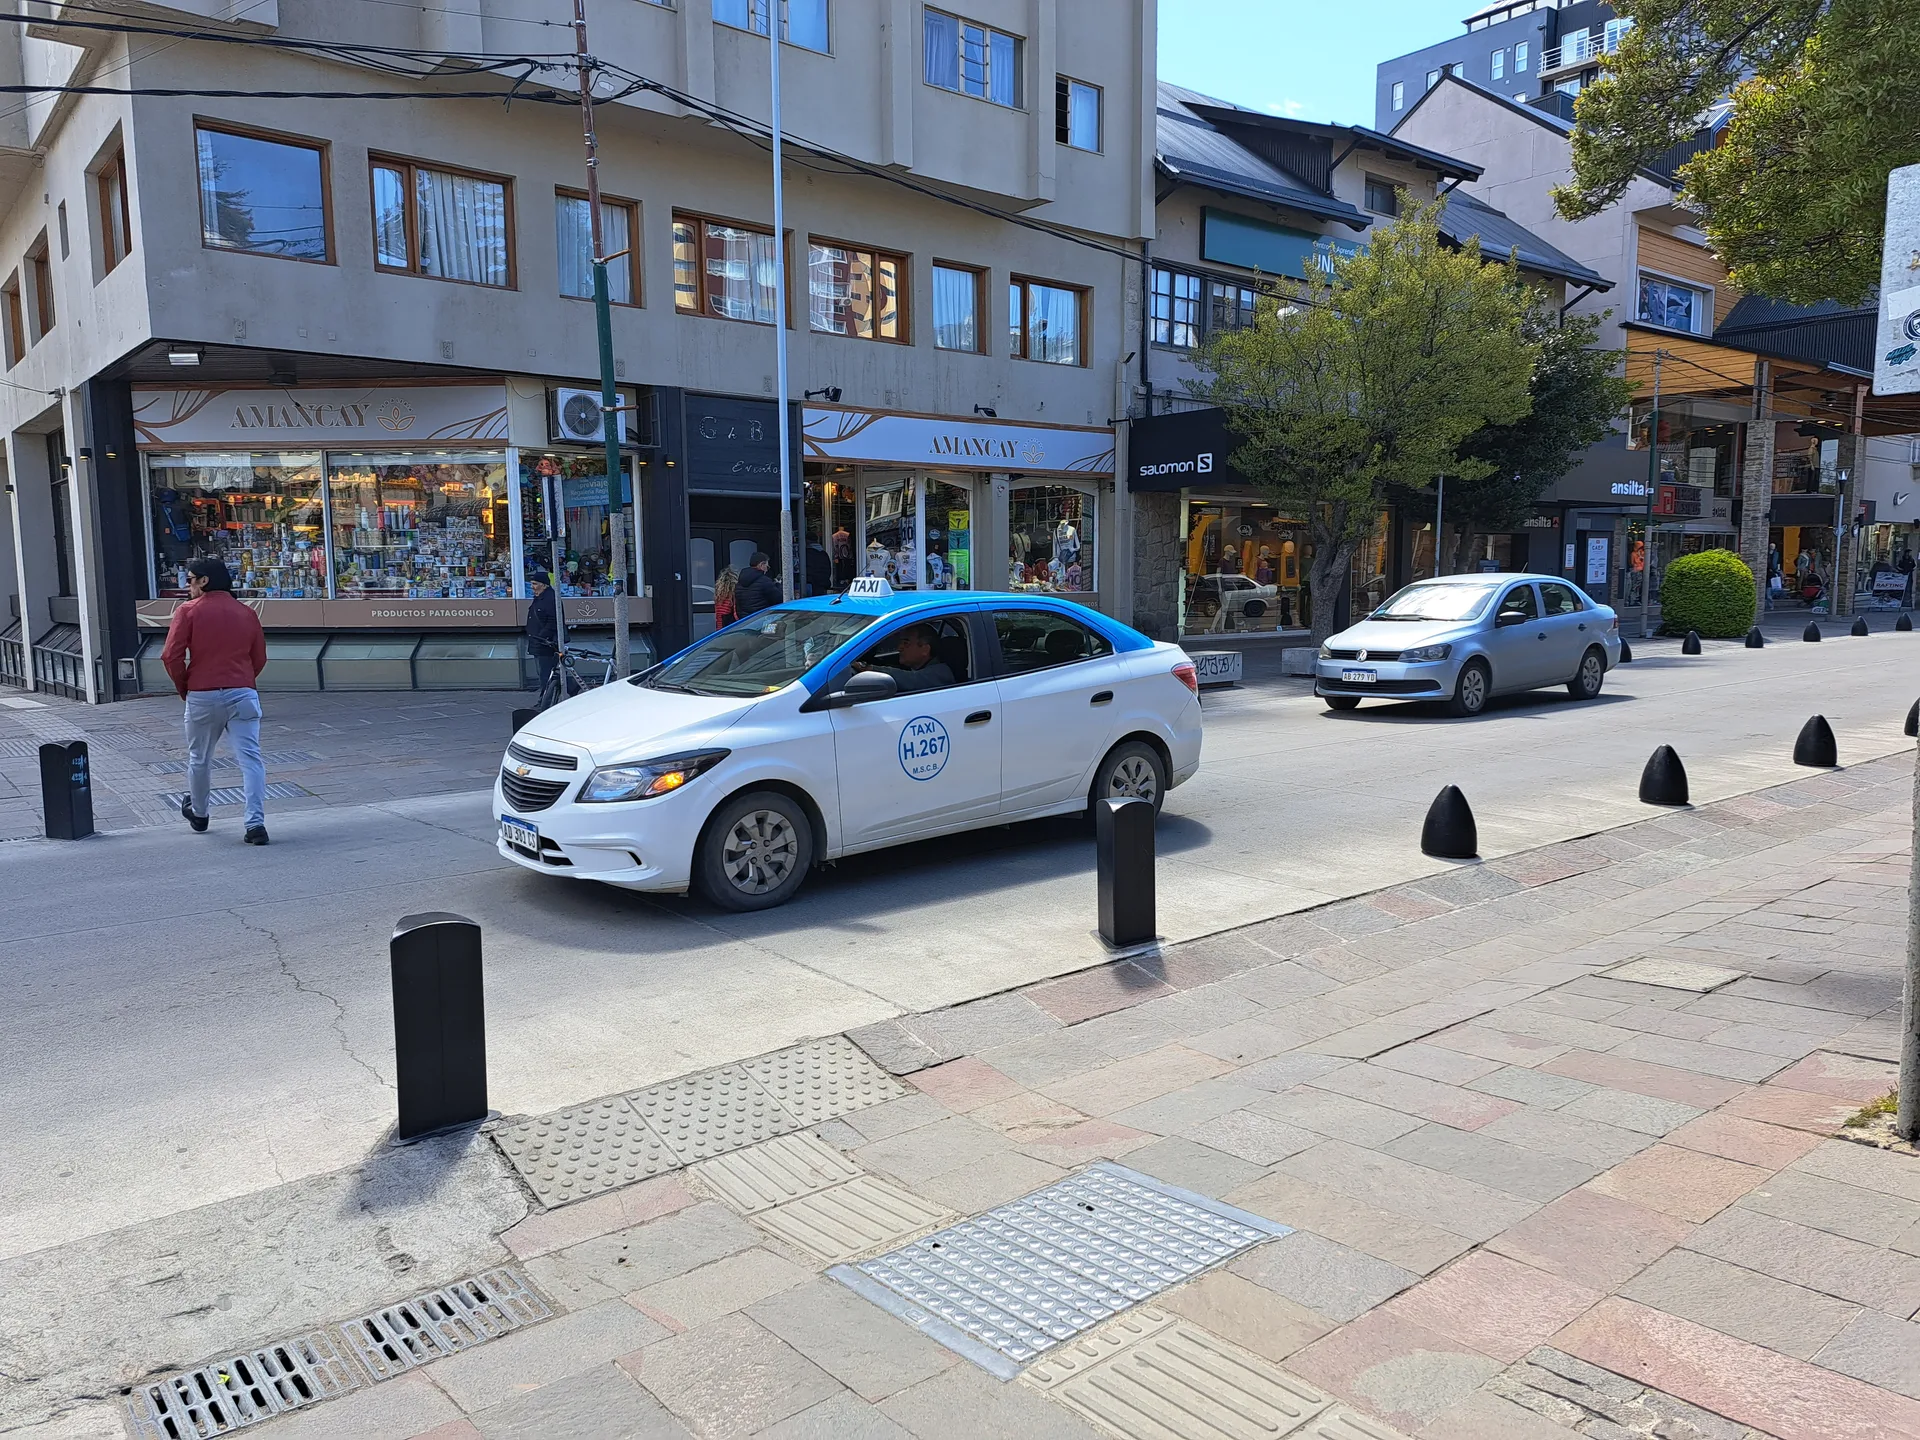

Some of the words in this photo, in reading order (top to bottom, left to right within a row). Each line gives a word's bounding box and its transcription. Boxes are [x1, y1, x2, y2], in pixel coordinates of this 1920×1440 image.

[230, 404, 371, 428] AMANCAY
[928, 435, 1019, 458] AMANCAY
[1140, 461, 1194, 476] salomon
[1611, 480, 1644, 496] ansilta
[1524, 517, 1551, 528] ansilta
[853, 580, 880, 593] TAXI
[371, 609, 426, 617] PRODUCTOS
[429, 609, 495, 617] PATAGONICOS
[1344, 672, 1352, 680] AB
[1353, 673, 1365, 681] 279
[910, 722, 936, 736] TAXI
[903, 736, 946, 760] H.267
[912, 763, 940, 774] M.S.C.B.
